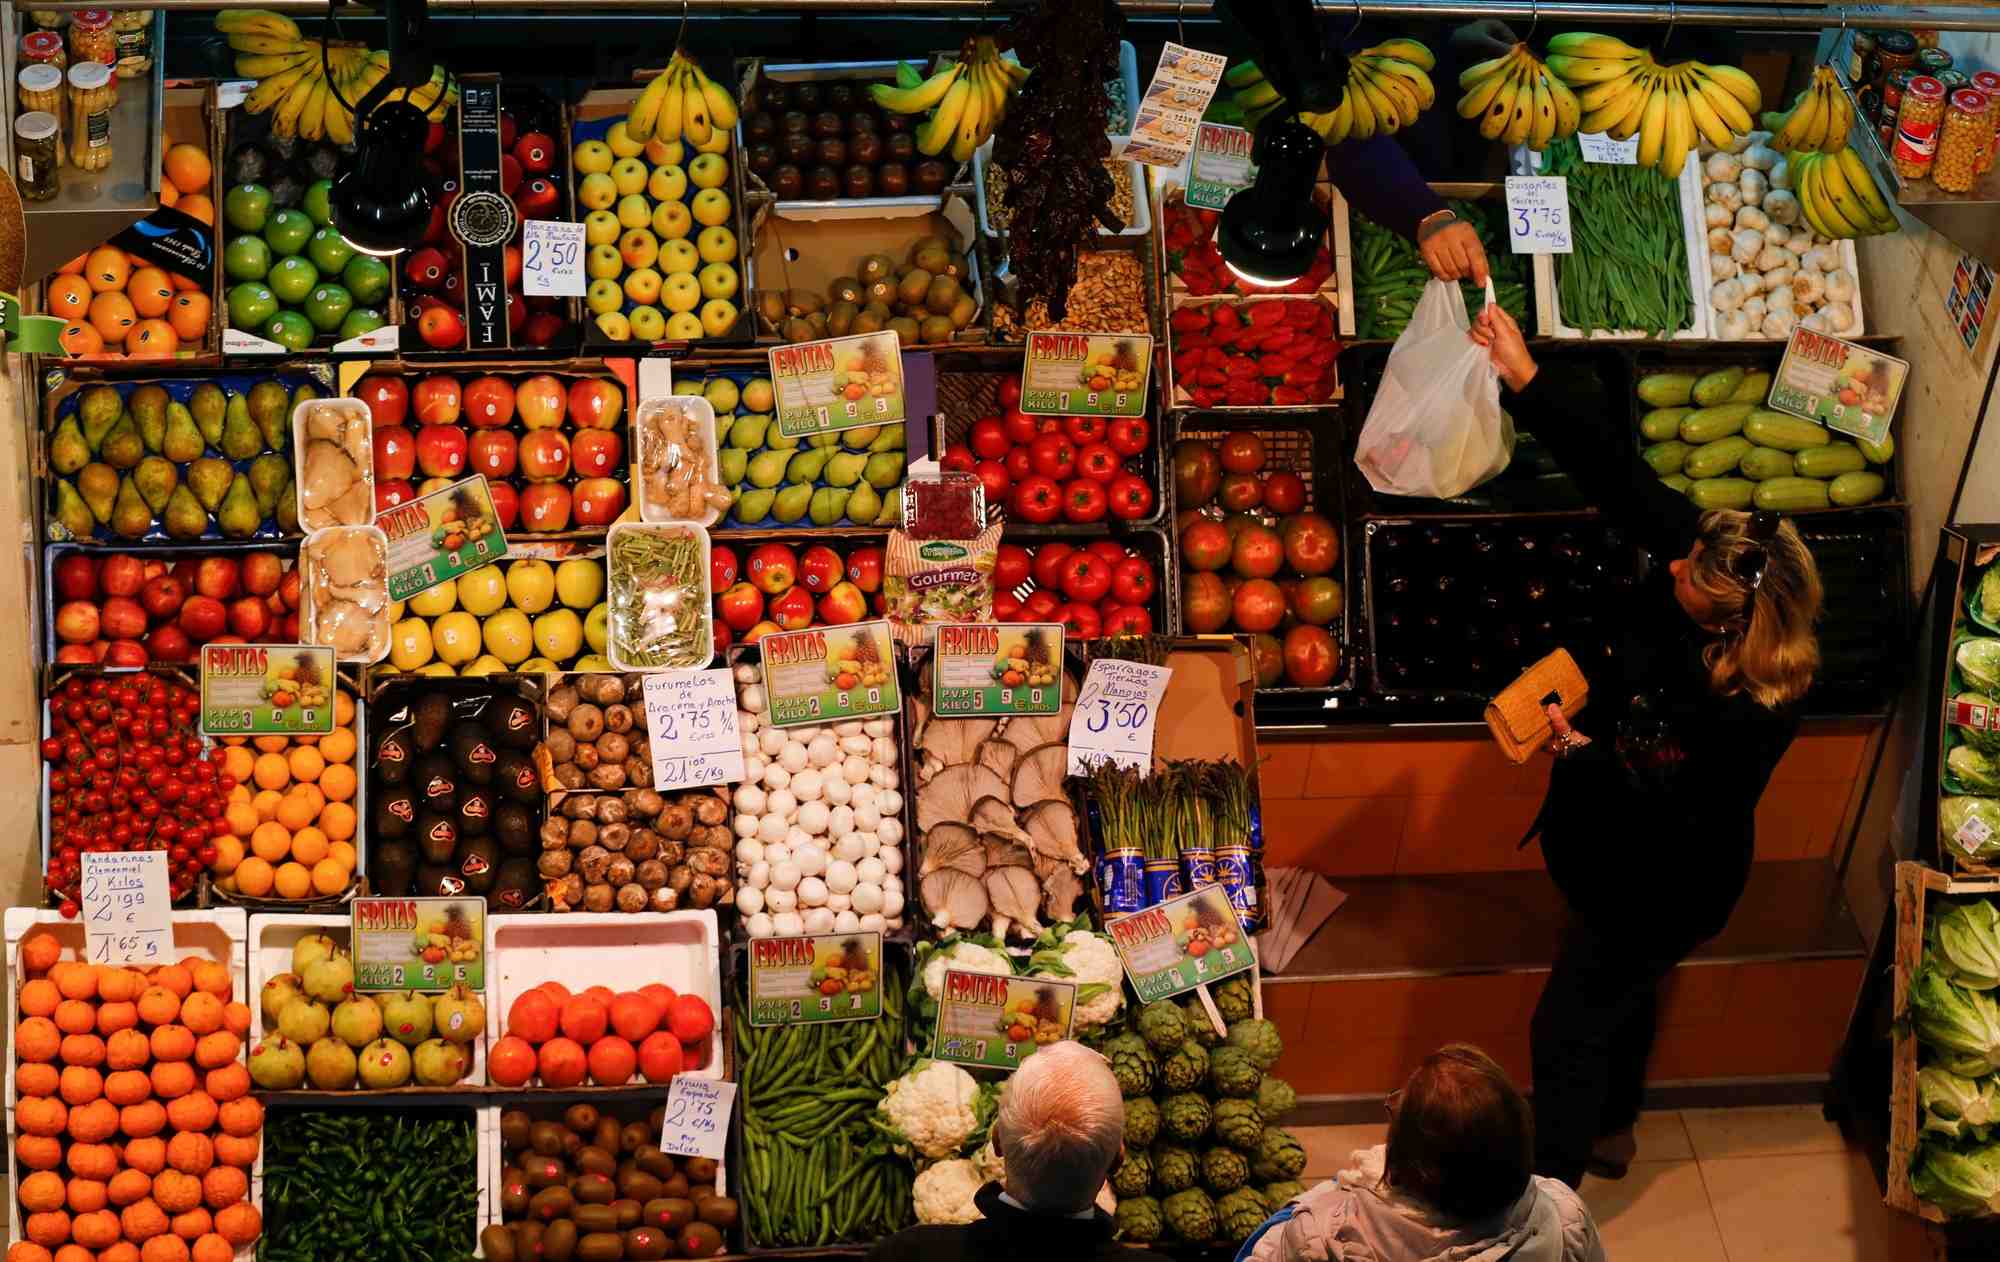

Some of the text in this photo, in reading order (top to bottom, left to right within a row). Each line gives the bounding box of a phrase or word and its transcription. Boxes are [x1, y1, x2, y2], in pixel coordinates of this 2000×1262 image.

[774, 341, 834, 377] FRUTAS
[1031, 335, 1089, 361] FRUTAS
[1027, 400, 1056, 409] KILO
[1061, 393, 1068, 409] 1
[1119, 394, 1127, 406] 5
[788, 419, 816, 432] KILO
[819, 408, 828, 427] 1
[876, 400, 885, 412] 5
[395, 578, 423, 594] KILO
[425, 565, 433, 582] 1
[911, 570, 980, 587] Gourmet
[767, 632, 828, 665] FRUTAS
[940, 626, 999, 656] FRUTAS
[207, 648, 268, 675] FRUTAS
[680, 690, 692, 699] de
[777, 709, 807, 721] KILO
[810, 698, 819, 715] 2
[870, 690, 878, 702] 0
[942, 701, 970, 710] KILO
[974, 691, 982, 708] 5
[1033, 690, 1041, 702] 0
[209, 720, 241, 729] KILO
[243, 711, 252, 728] 3
[306, 710, 315, 722] 0
[660, 711, 712, 740] 2'75
[1088, 699, 1149, 733] 3'50
[86, 876, 98, 901] 2
[93, 892, 145, 921] 2'99
[356, 899, 417, 930] FRUTAS
[1112, 909, 1172, 950] FRUTAS
[96, 936, 140, 963] 1'65
[752, 937, 816, 967] FRUTAS
[394, 968, 403, 984] 2
[458, 966, 466, 978] 5
[946, 972, 1008, 1007] FRUTAS
[1144, 982, 1171, 997] KILO
[791, 1001, 800, 1017] 2
[943, 1047, 971, 1058] KILO
[976, 1041, 985, 1058] 1
